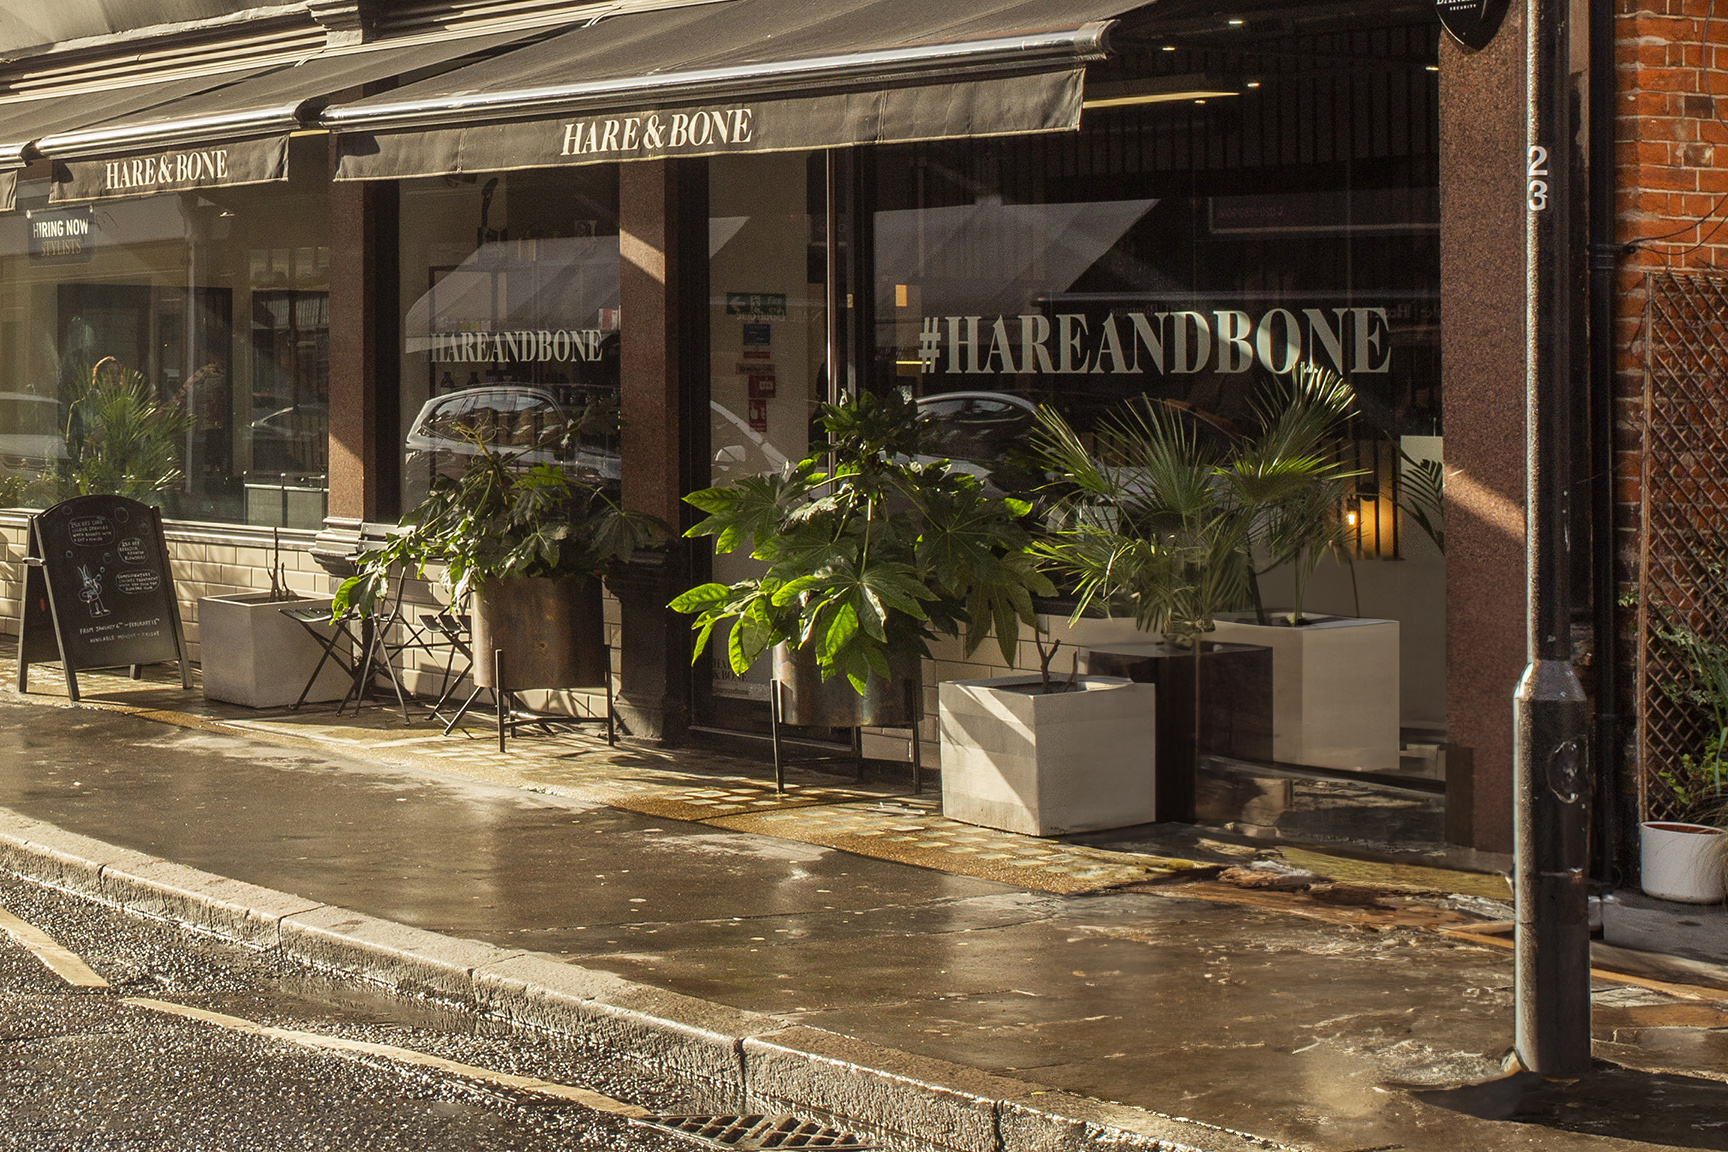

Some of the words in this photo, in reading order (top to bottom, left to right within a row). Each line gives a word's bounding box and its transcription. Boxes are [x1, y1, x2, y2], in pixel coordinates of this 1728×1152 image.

[1449, 3, 1477, 11] SECURITY
[32, 221, 64, 239] HIRING
[66, 218, 89, 236] NOW
[41, 239, 82, 257] STYLISTS
[918, 307, 1392, 376] #HAREANDBONE
[79, 627, 94, 635] FROM
[89, 635, 115, 643] AVAILABLE
